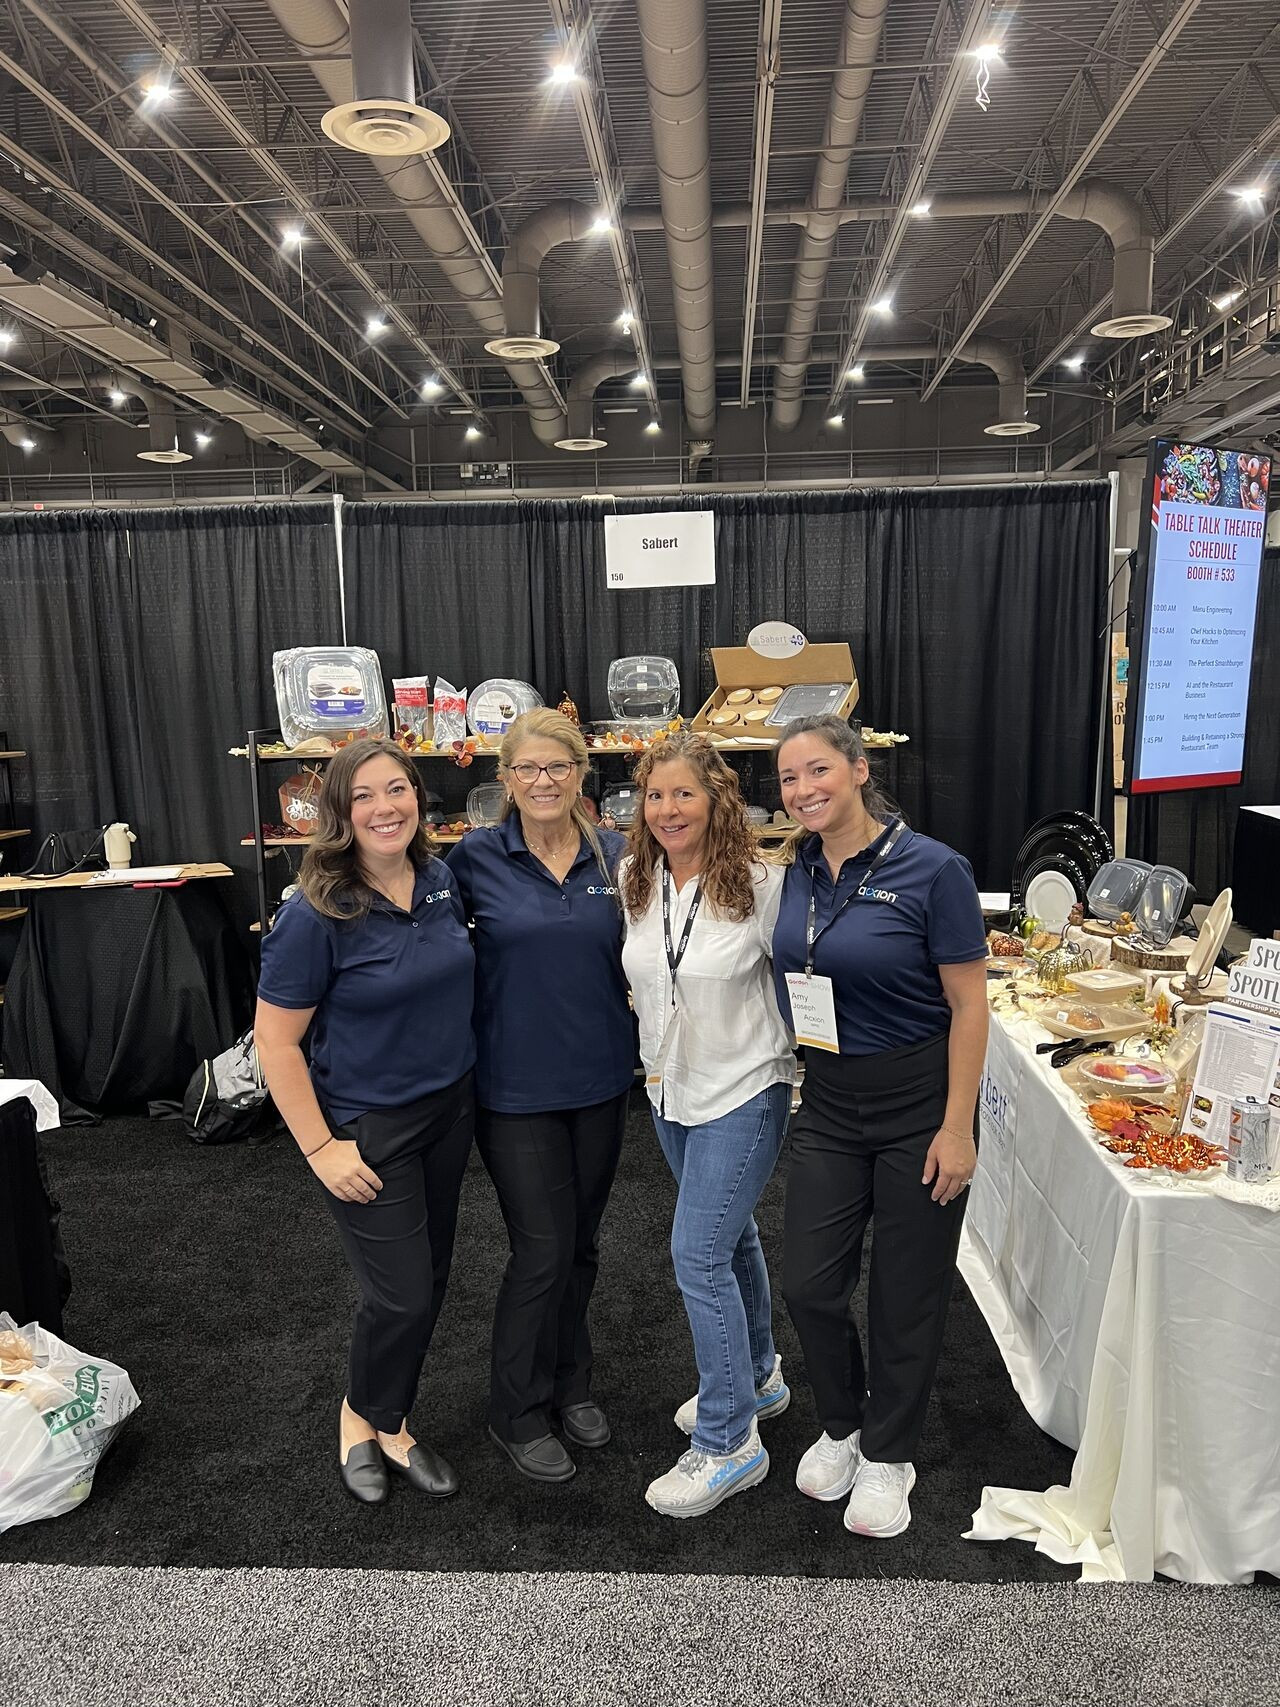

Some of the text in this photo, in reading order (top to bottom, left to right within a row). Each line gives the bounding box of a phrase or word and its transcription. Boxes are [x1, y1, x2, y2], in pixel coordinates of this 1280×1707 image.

[1165, 513, 1262, 538] TABLE TALK THEATER
[642, 537, 678, 550] Sabert
[1189, 540, 1238, 560] SCHEDULE
[611, 572, 624, 581] 150
[1187, 566, 1213, 580] BOOTH
[1221, 568, 1235, 582] 533
[1153, 604, 1176, 612] 10:00 AM
[1192, 605, 1233, 615] Menu Engineering
[1190, 627, 1202, 635] Chef
[760, 635, 787, 644] Sabert
[1188, 659, 1243, 668] The Perfect Smashburger
[1183, 713, 1197, 721] Hiring
[1217, 711, 1241, 719] Generation
[1181, 733, 1201, 742] Building
[1205, 733, 1226, 741] Retaining
[1230, 732, 1245, 741] Strong
[1180, 744, 1206, 752] Restaurant
[858, 886, 898, 903] acxion
[791, 992, 809, 1002] Amy
[793, 1003, 816, 1012] Joseph
[1227, 997, 1269, 1012] PARTNERSHIP
[803, 1014, 825, 1024] Acxion
